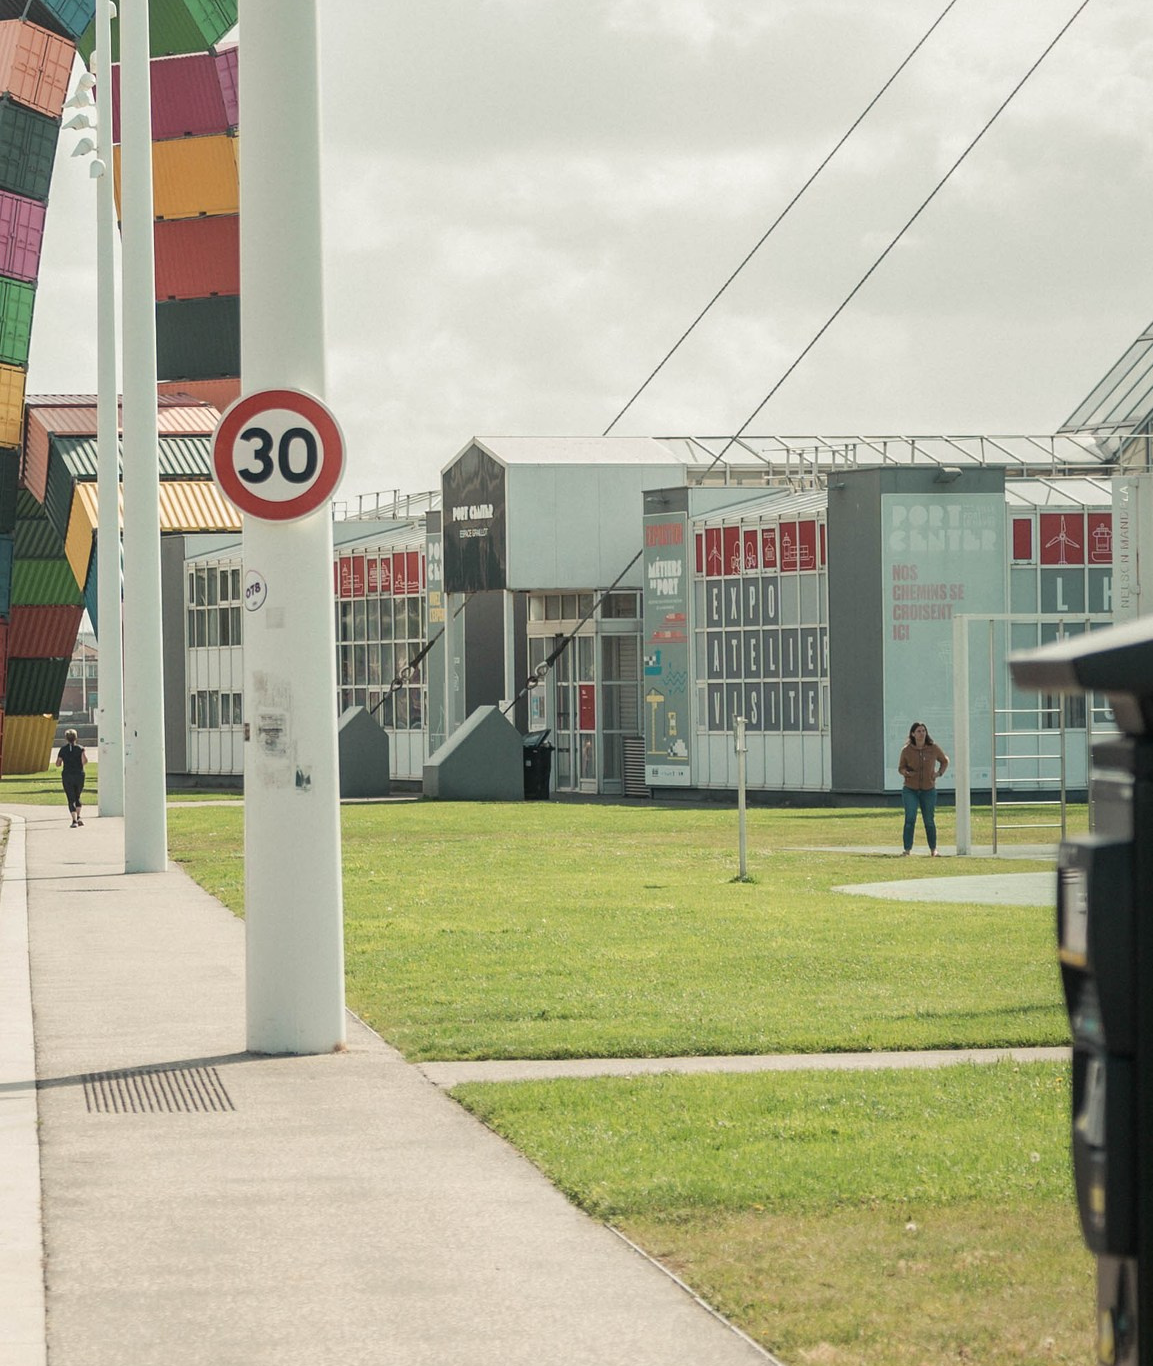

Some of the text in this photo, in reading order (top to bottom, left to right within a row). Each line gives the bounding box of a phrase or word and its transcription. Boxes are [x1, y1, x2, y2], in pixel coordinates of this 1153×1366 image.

[238, 427, 317, 484] 30
[892, 505, 961, 527] PORT
[889, 529, 997, 551] CENTER
[892, 564, 918, 581] NOS
[712, 585, 775, 620] EXPO
[892, 584, 965, 601] CHEMINS SE
[892, 603, 954, 621] CROISENT
[893, 624, 910, 641] ICI
[714, 691, 815, 725] VISITE
